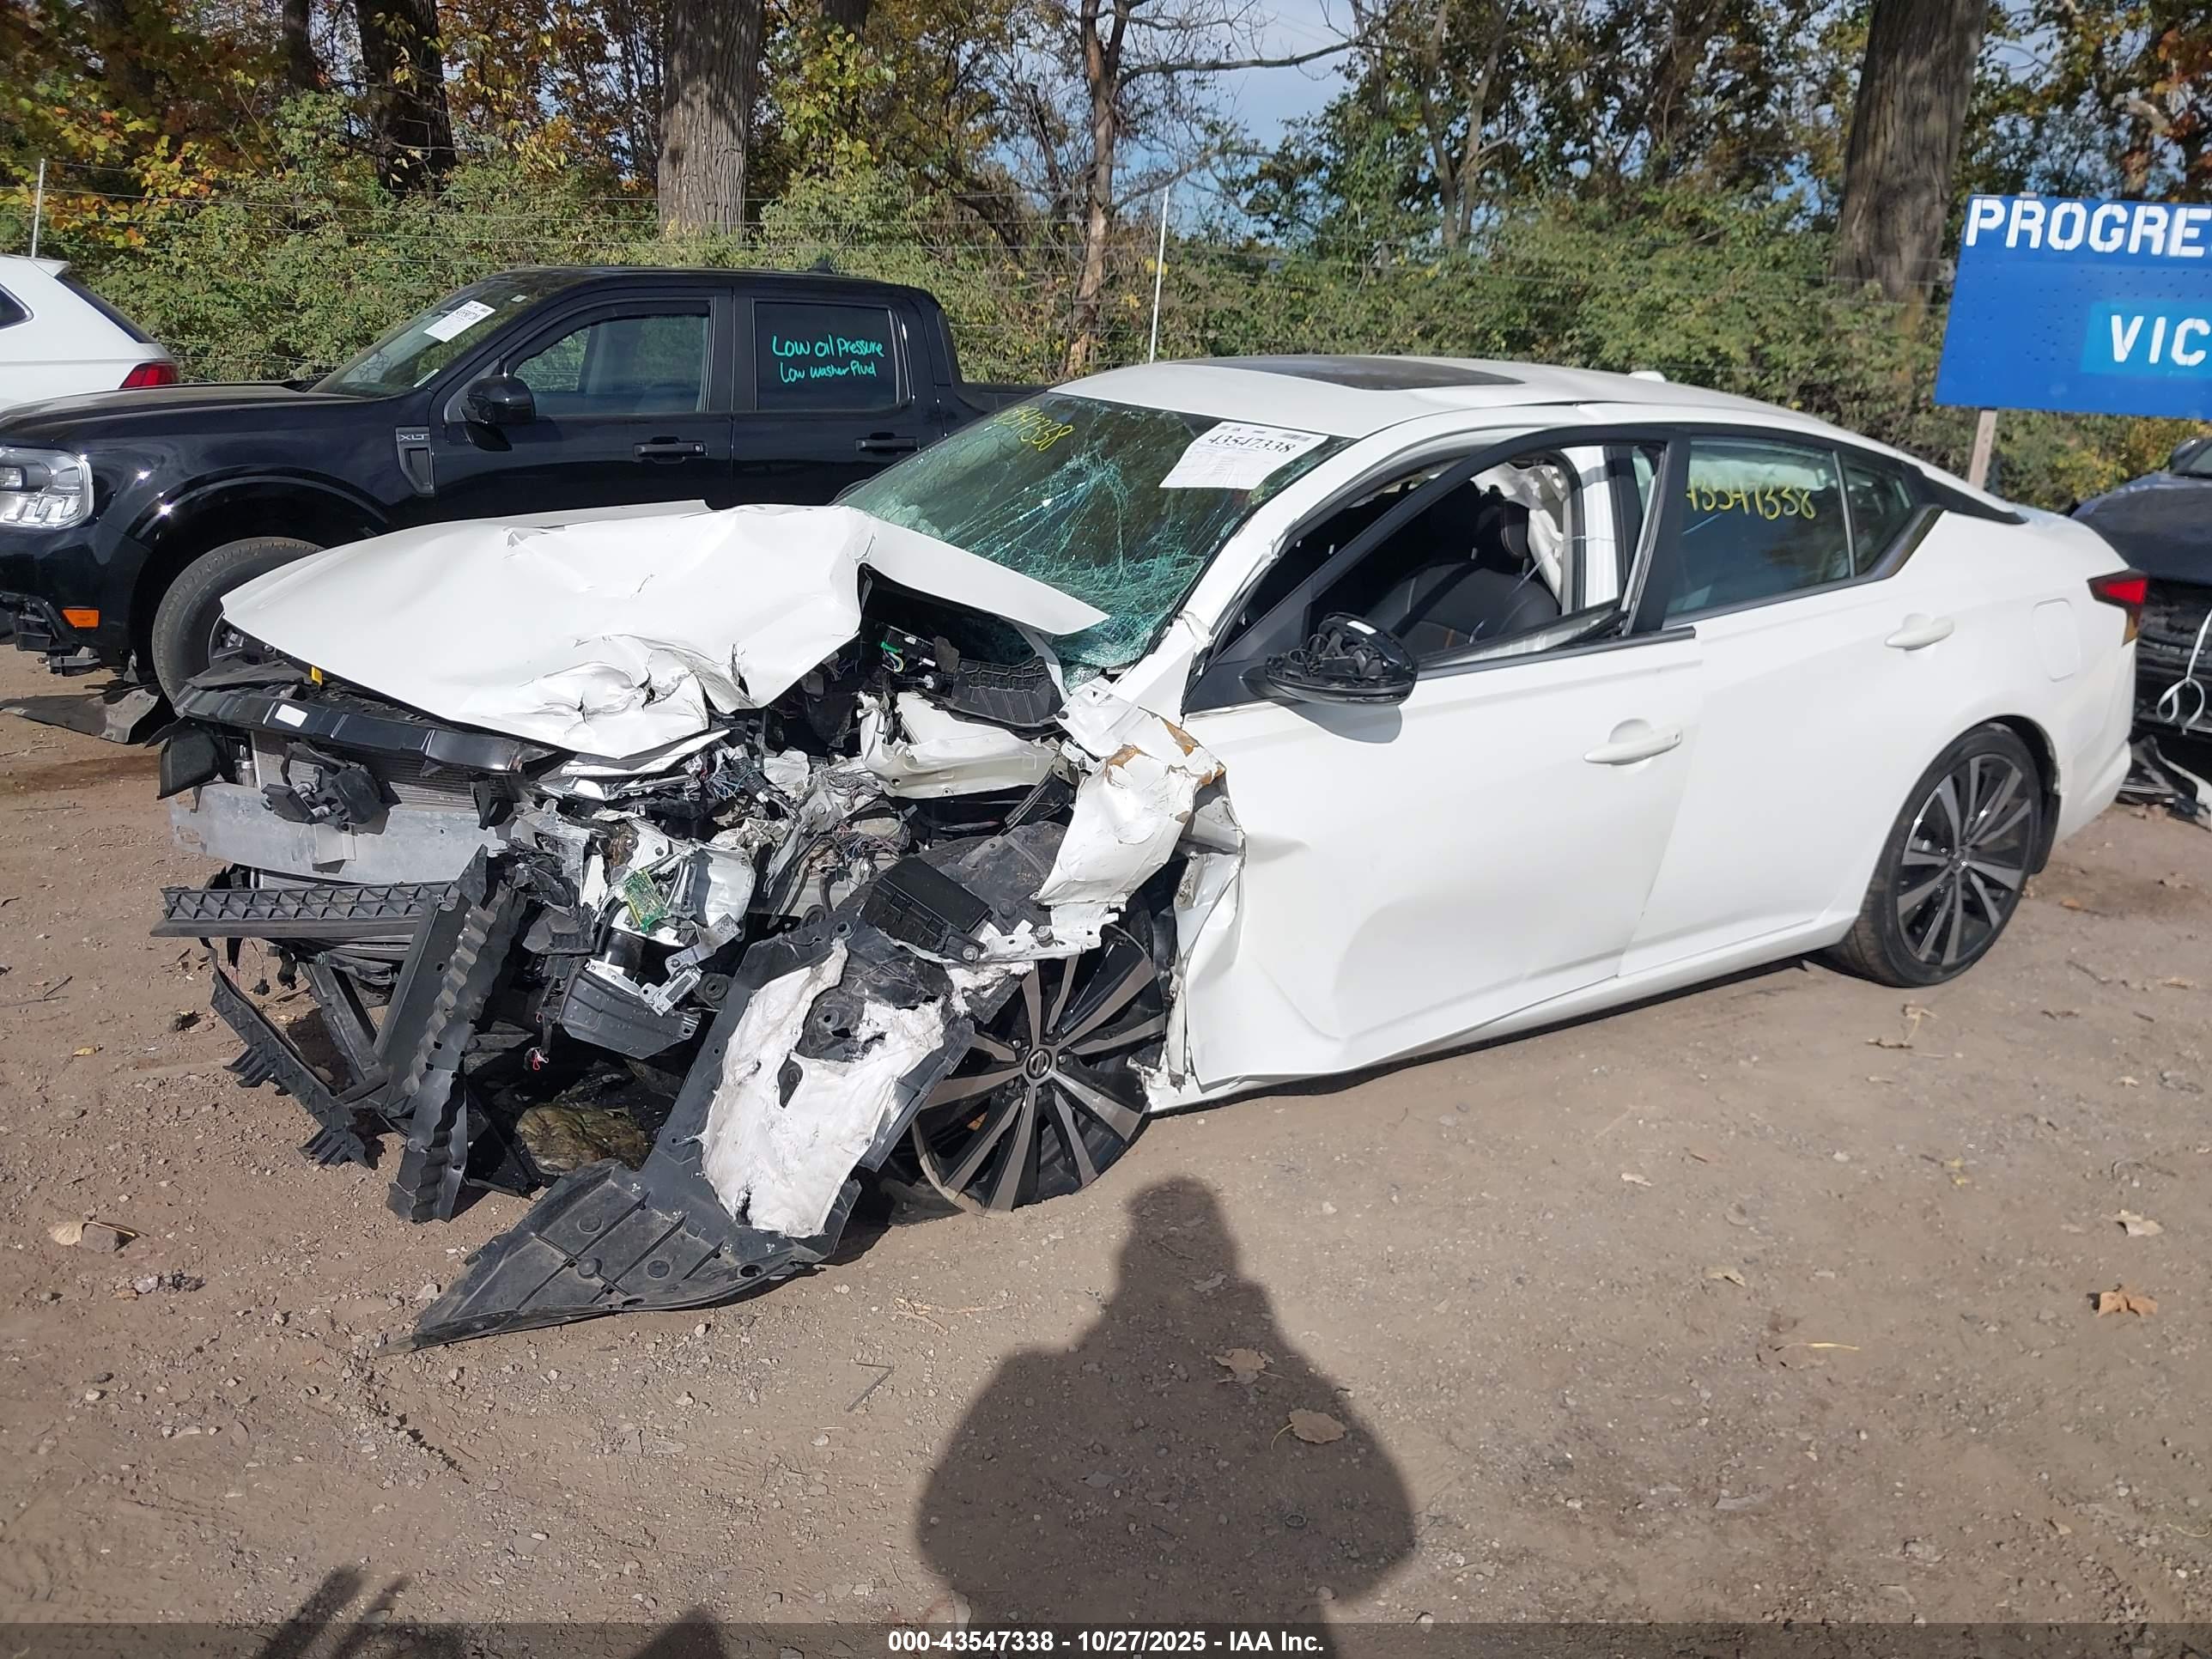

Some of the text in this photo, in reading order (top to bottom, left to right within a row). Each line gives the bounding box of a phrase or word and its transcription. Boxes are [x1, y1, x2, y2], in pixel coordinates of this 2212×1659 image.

[1966, 198, 2212, 258] PROGRE
[2111, 314, 2211, 366] VIC
[1207, 434, 1296, 453] 43547338
